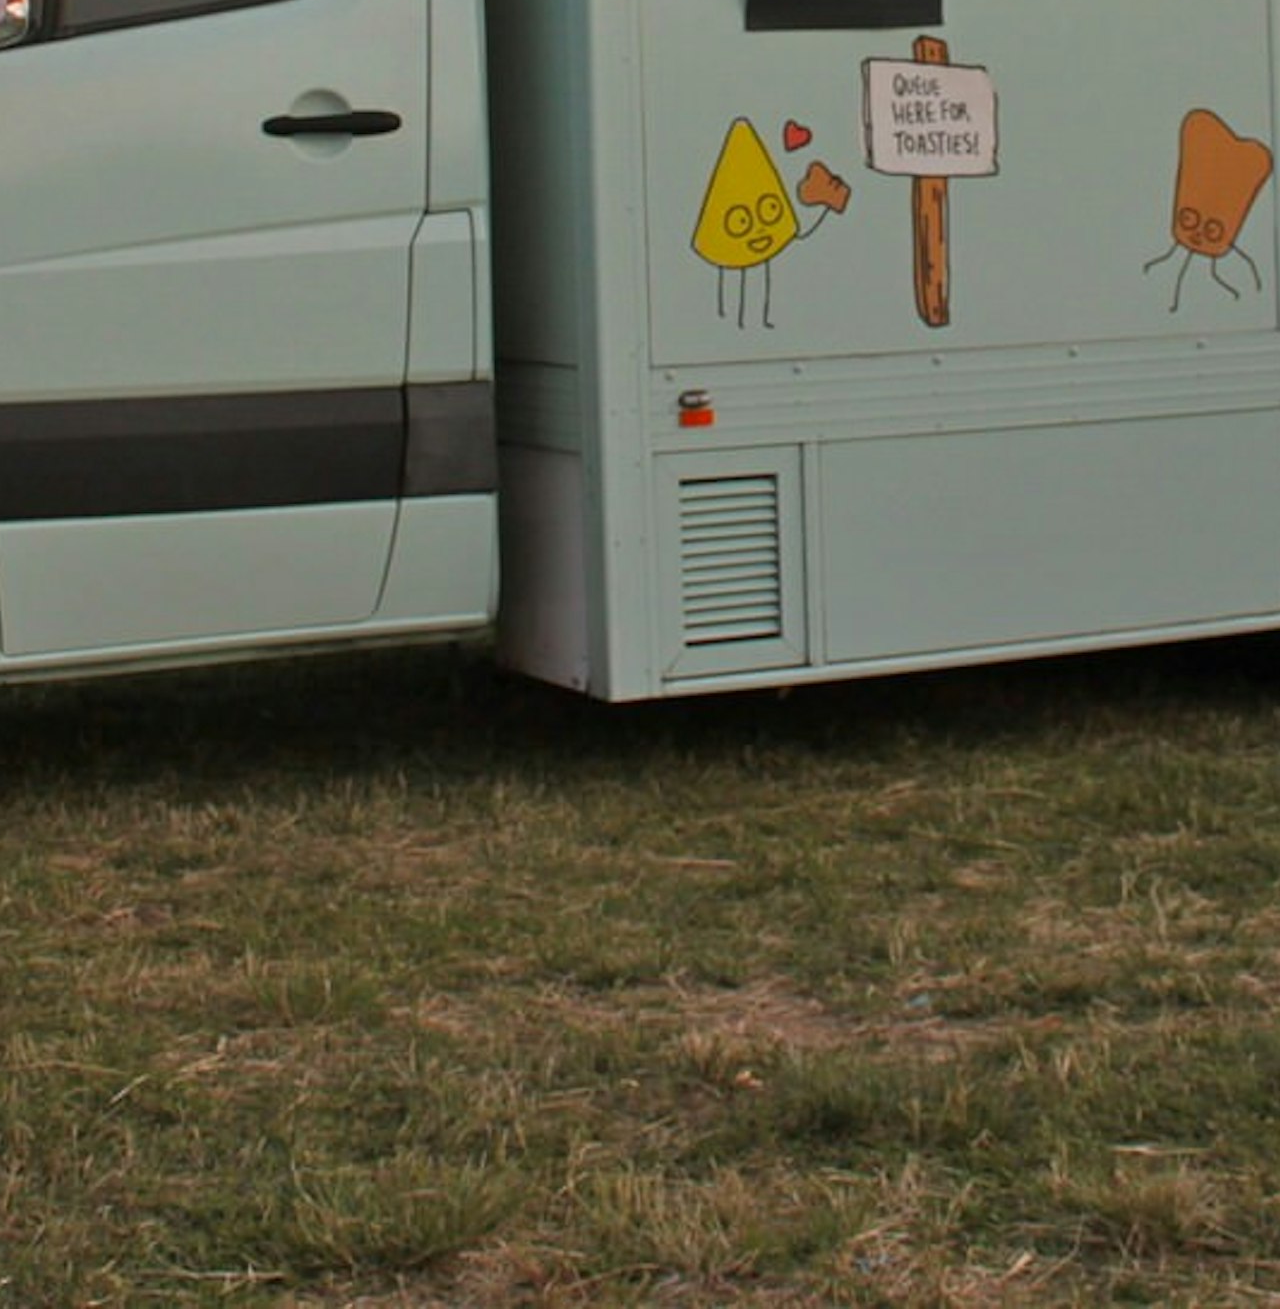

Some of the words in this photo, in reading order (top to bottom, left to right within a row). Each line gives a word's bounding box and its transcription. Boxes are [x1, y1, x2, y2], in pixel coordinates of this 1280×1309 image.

[892, 73, 940, 97] QUEUE
[892, 100, 936, 125] HERE
[939, 99, 972, 123] FOR
[892, 131, 980, 157] TOASTIES!
